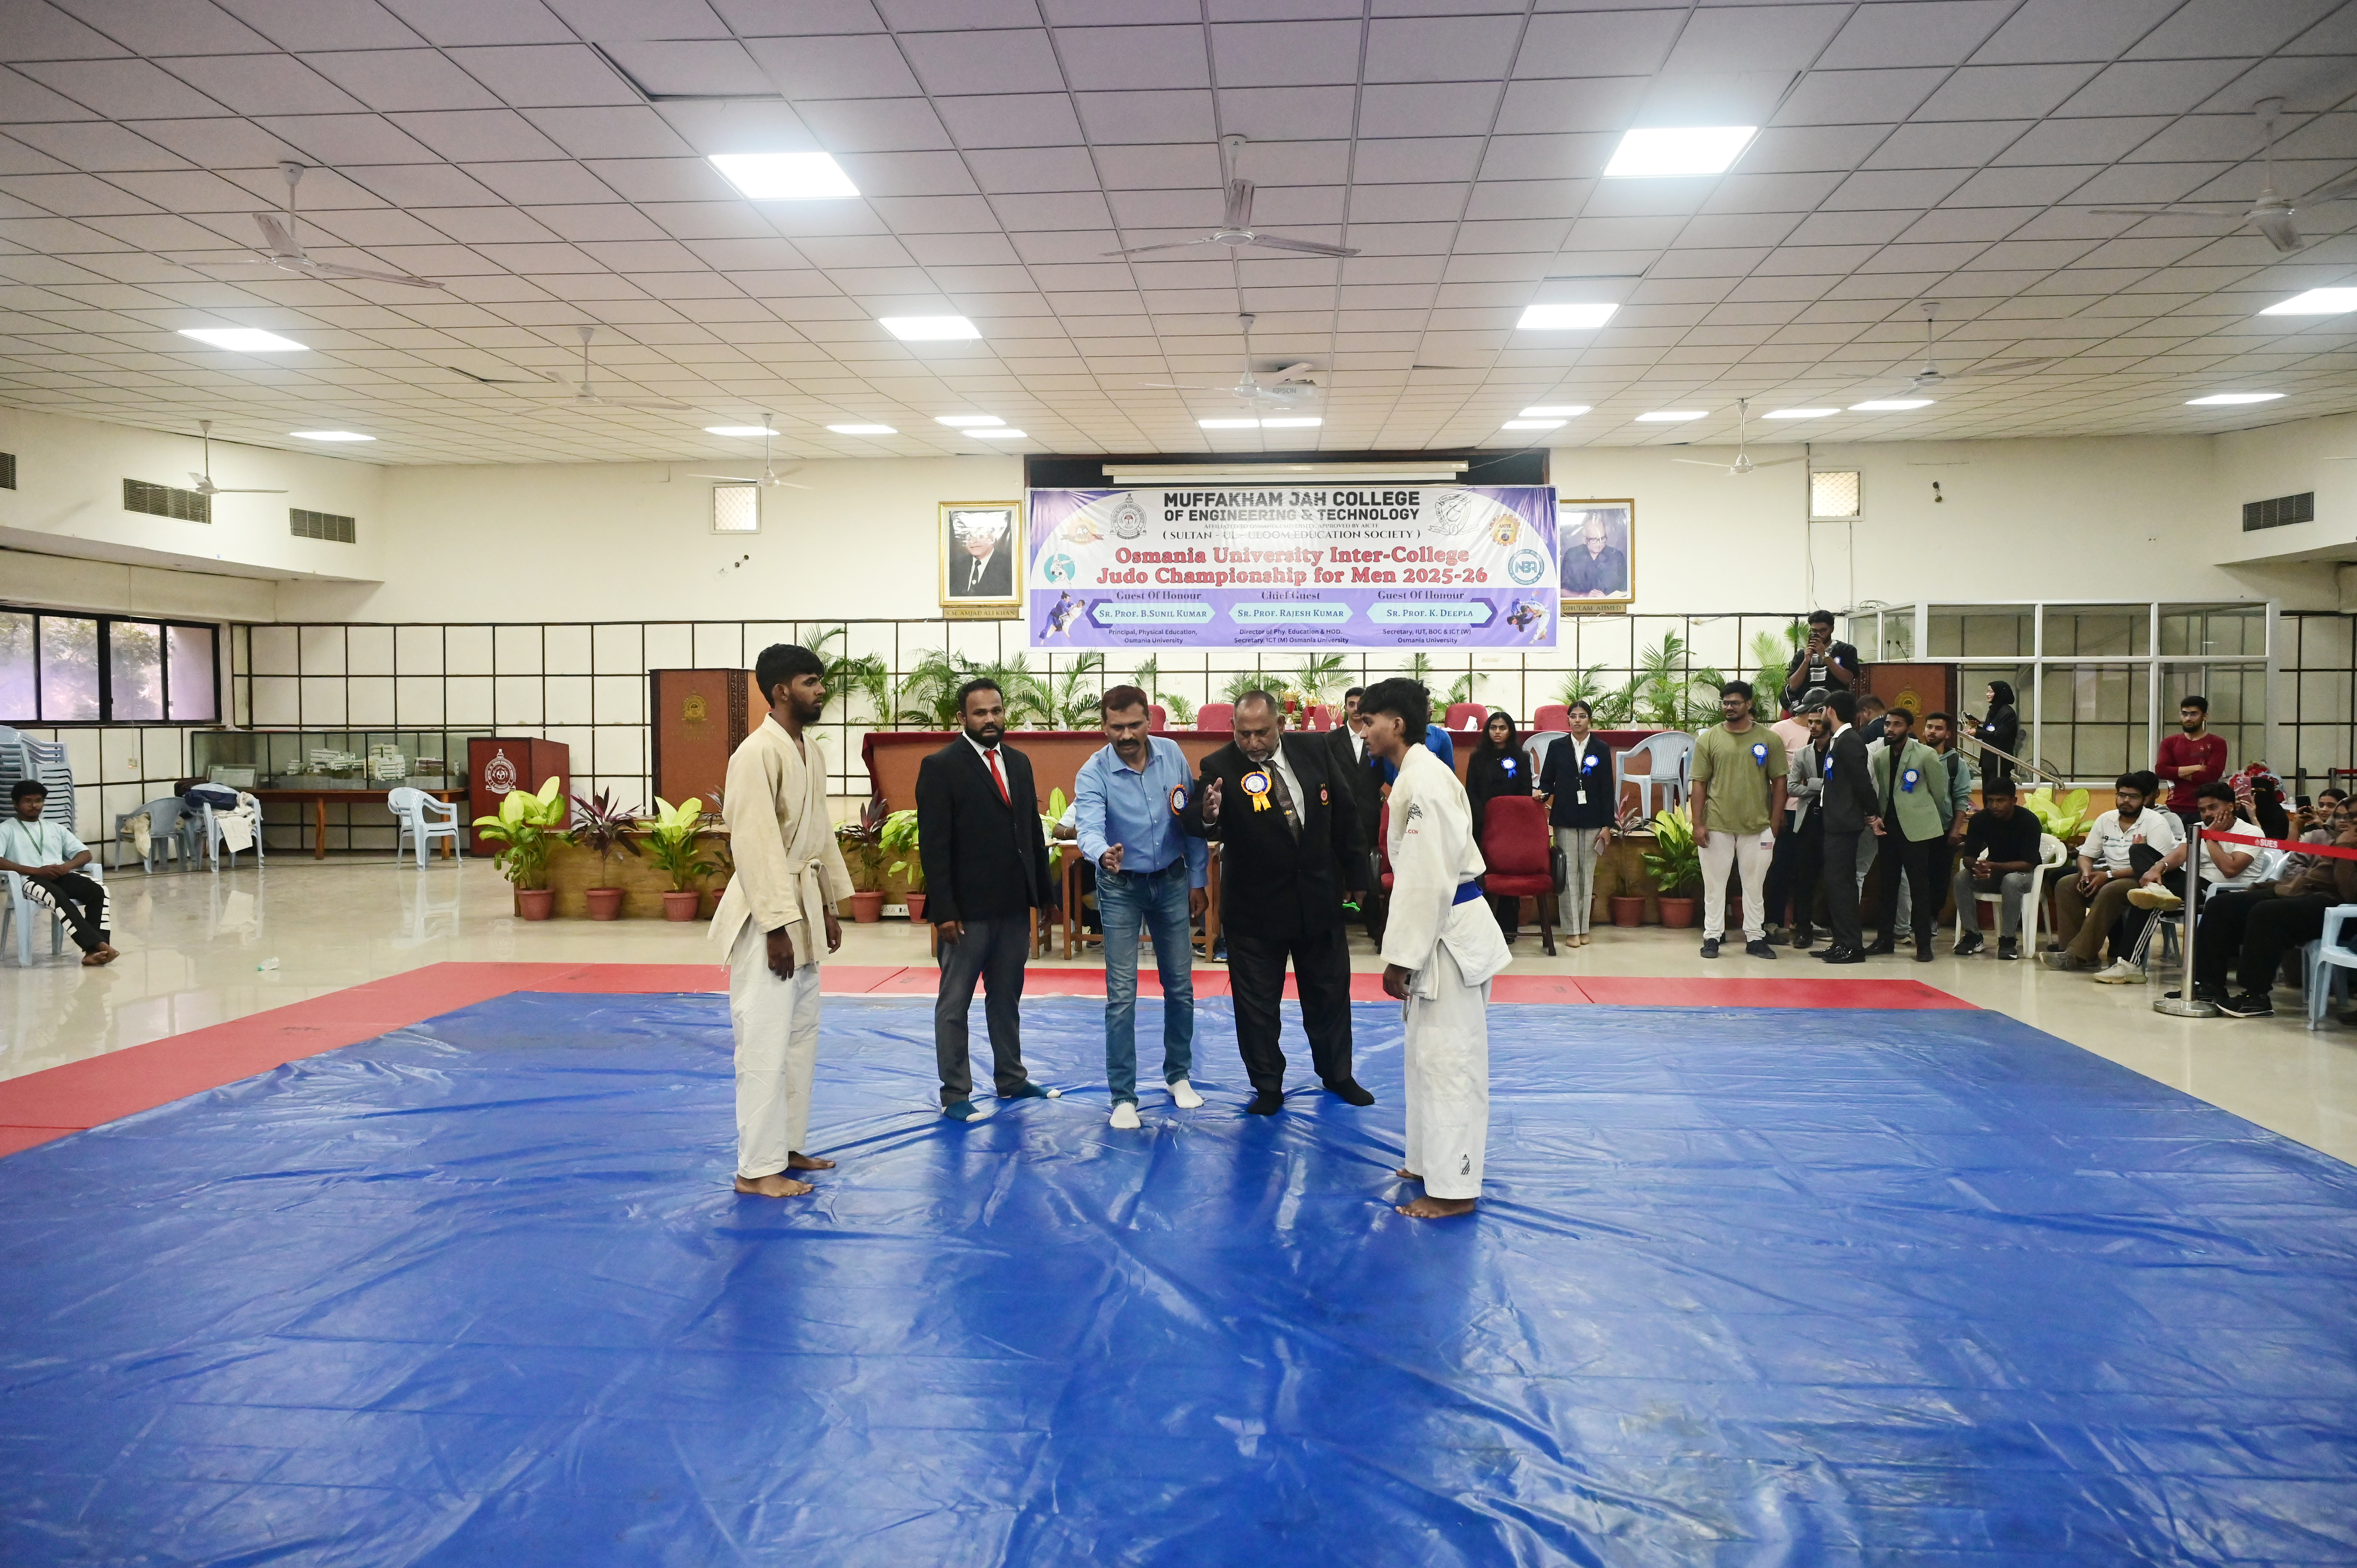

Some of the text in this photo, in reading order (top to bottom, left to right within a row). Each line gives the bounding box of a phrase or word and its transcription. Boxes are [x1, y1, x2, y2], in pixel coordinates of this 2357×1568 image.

[1164, 491, 1420, 507] MUFFAKHAM JAH COLLEGE
[1164, 508, 1419, 521] OF ENGINEERING & TECHNOLOGY
[1170, 531, 1212, 539] SULTAN
[1223, 531, 1238, 539] UL
[1248, 531, 1291, 539] ULOOM
[1294, 530, 1360, 539] EDUCATION
[1364, 530, 1413, 539] SOCIETY
[1115, 546, 1469, 566] Osmania University Inter-College
[1515, 561, 1537, 573] NBA
[1096, 567, 1488, 586] Judo Championship for Men 2025-26
[1117, 591, 1201, 600] Guest Of Honour
[1262, 591, 1320, 600] Chief Guest
[1378, 591, 1464, 599] Guest Of Honour
[2260, 839, 2277, 848] SUES
